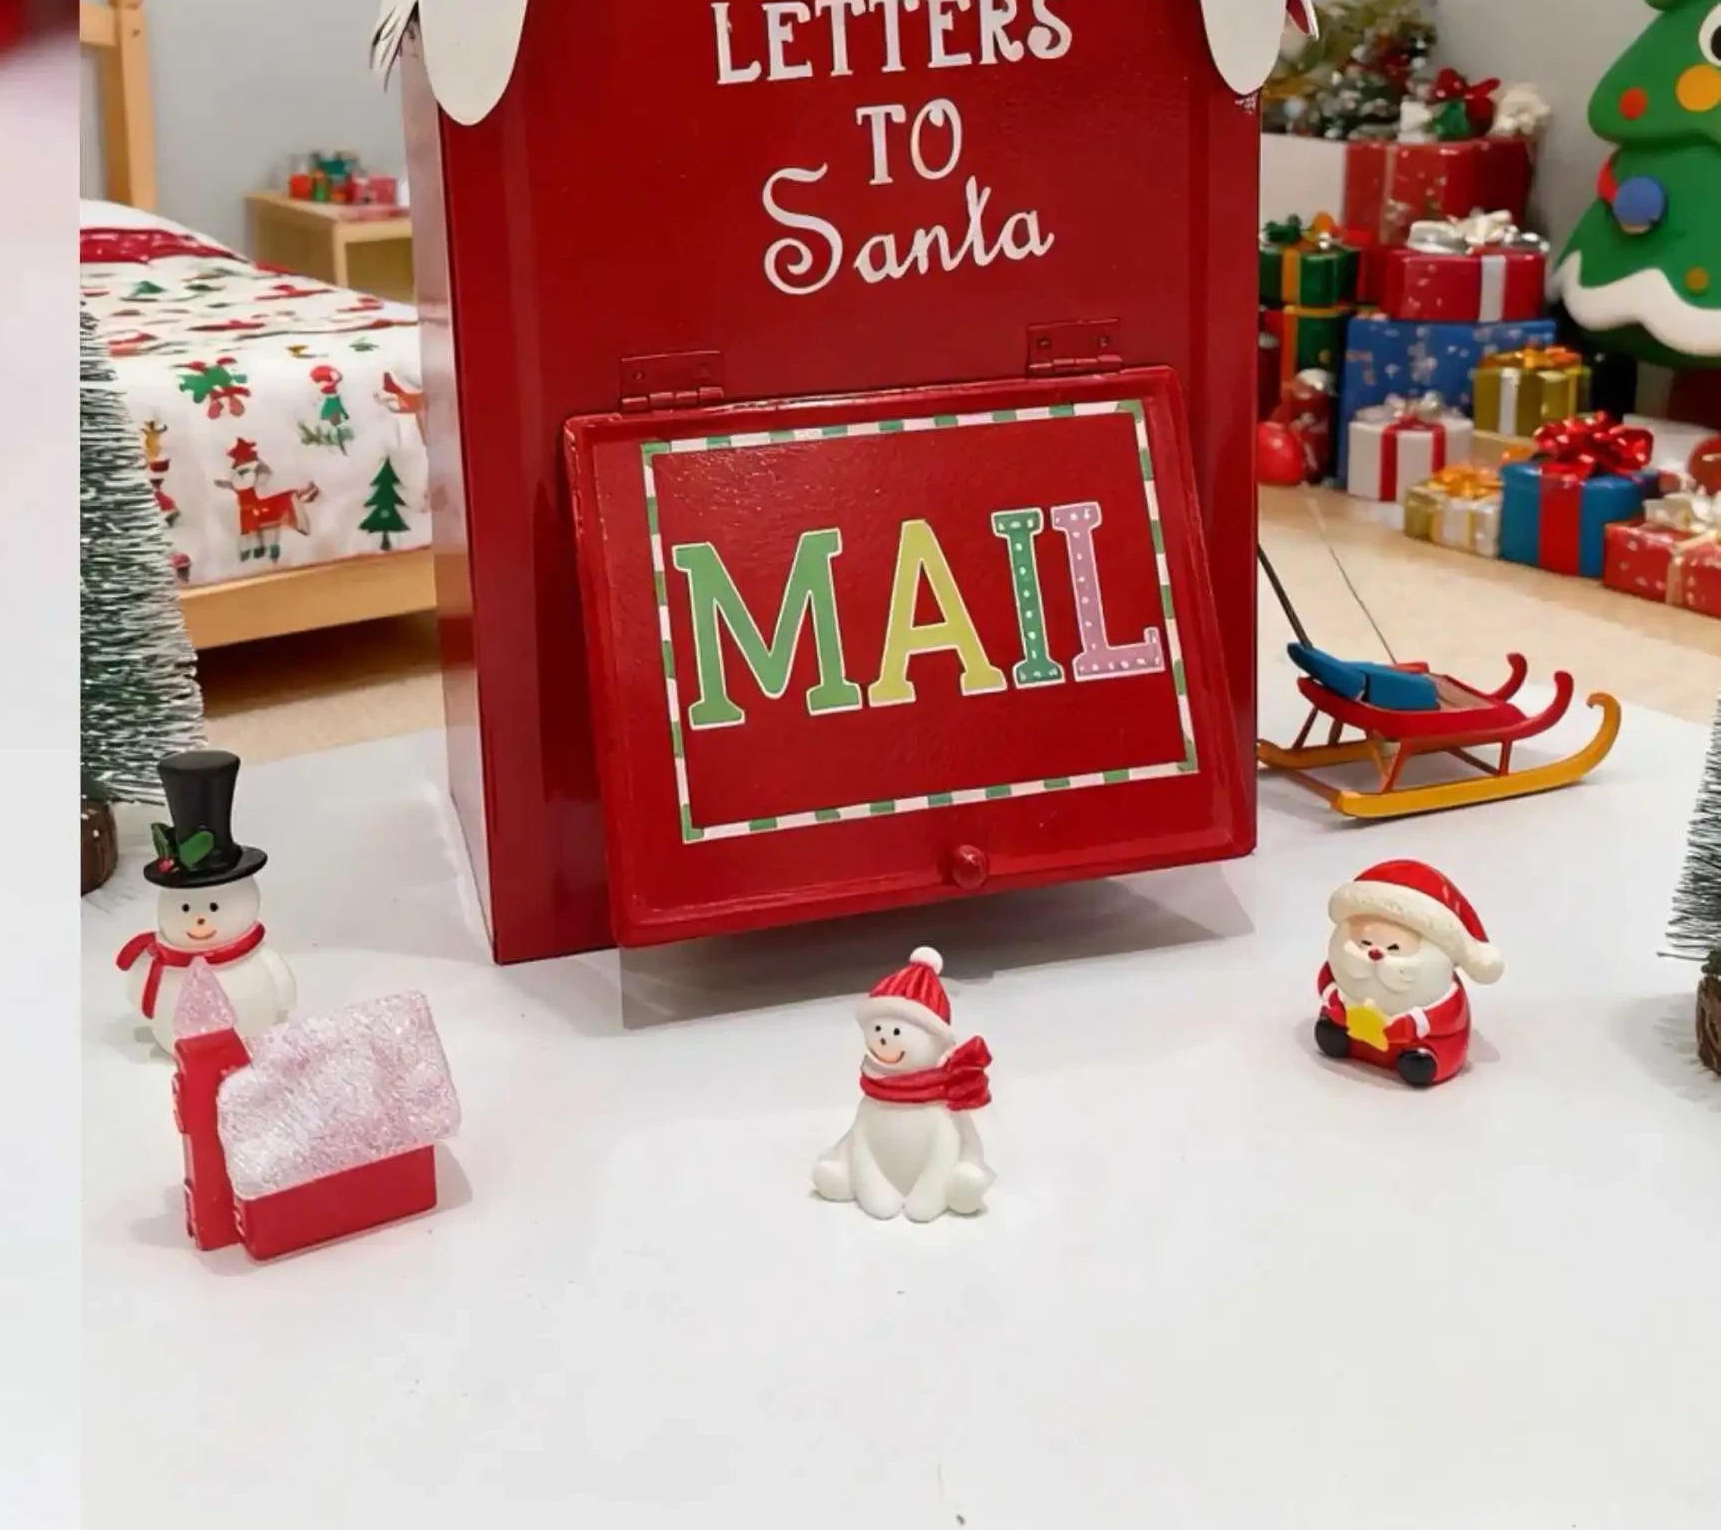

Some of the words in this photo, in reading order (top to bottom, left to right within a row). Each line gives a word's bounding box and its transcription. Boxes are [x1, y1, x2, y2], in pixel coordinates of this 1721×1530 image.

[855, 97, 963, 186] TO
[761, 162, 1056, 296] Santa
[671, 501, 1166, 731] MAIL
